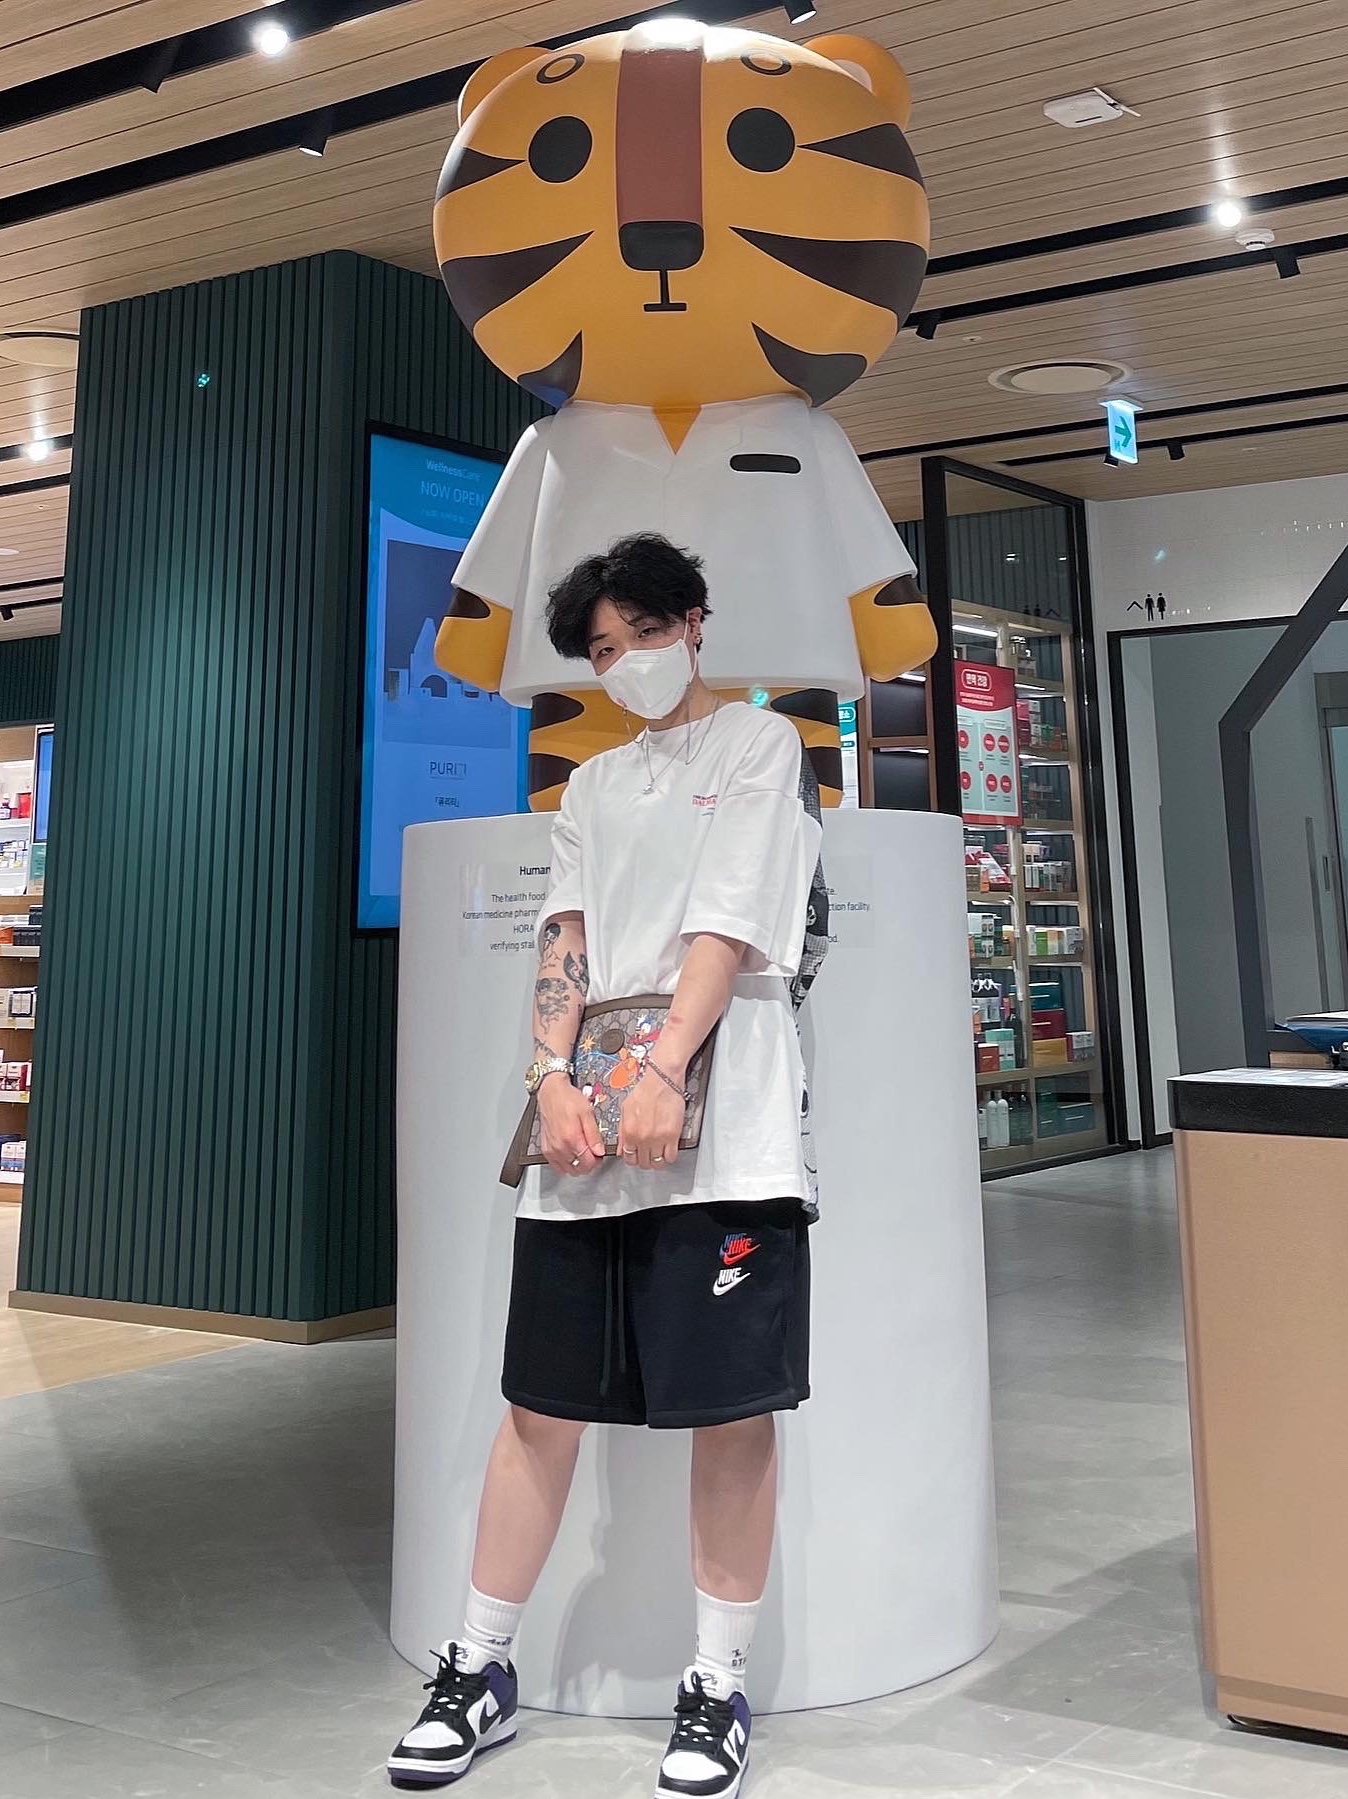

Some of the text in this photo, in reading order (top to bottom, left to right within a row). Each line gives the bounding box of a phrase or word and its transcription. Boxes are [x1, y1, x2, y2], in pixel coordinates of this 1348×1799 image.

[421, 481, 485, 507] NOW OPEN
[491, 892, 546, 903] The health food
[490, 941, 519, 952] verifying
